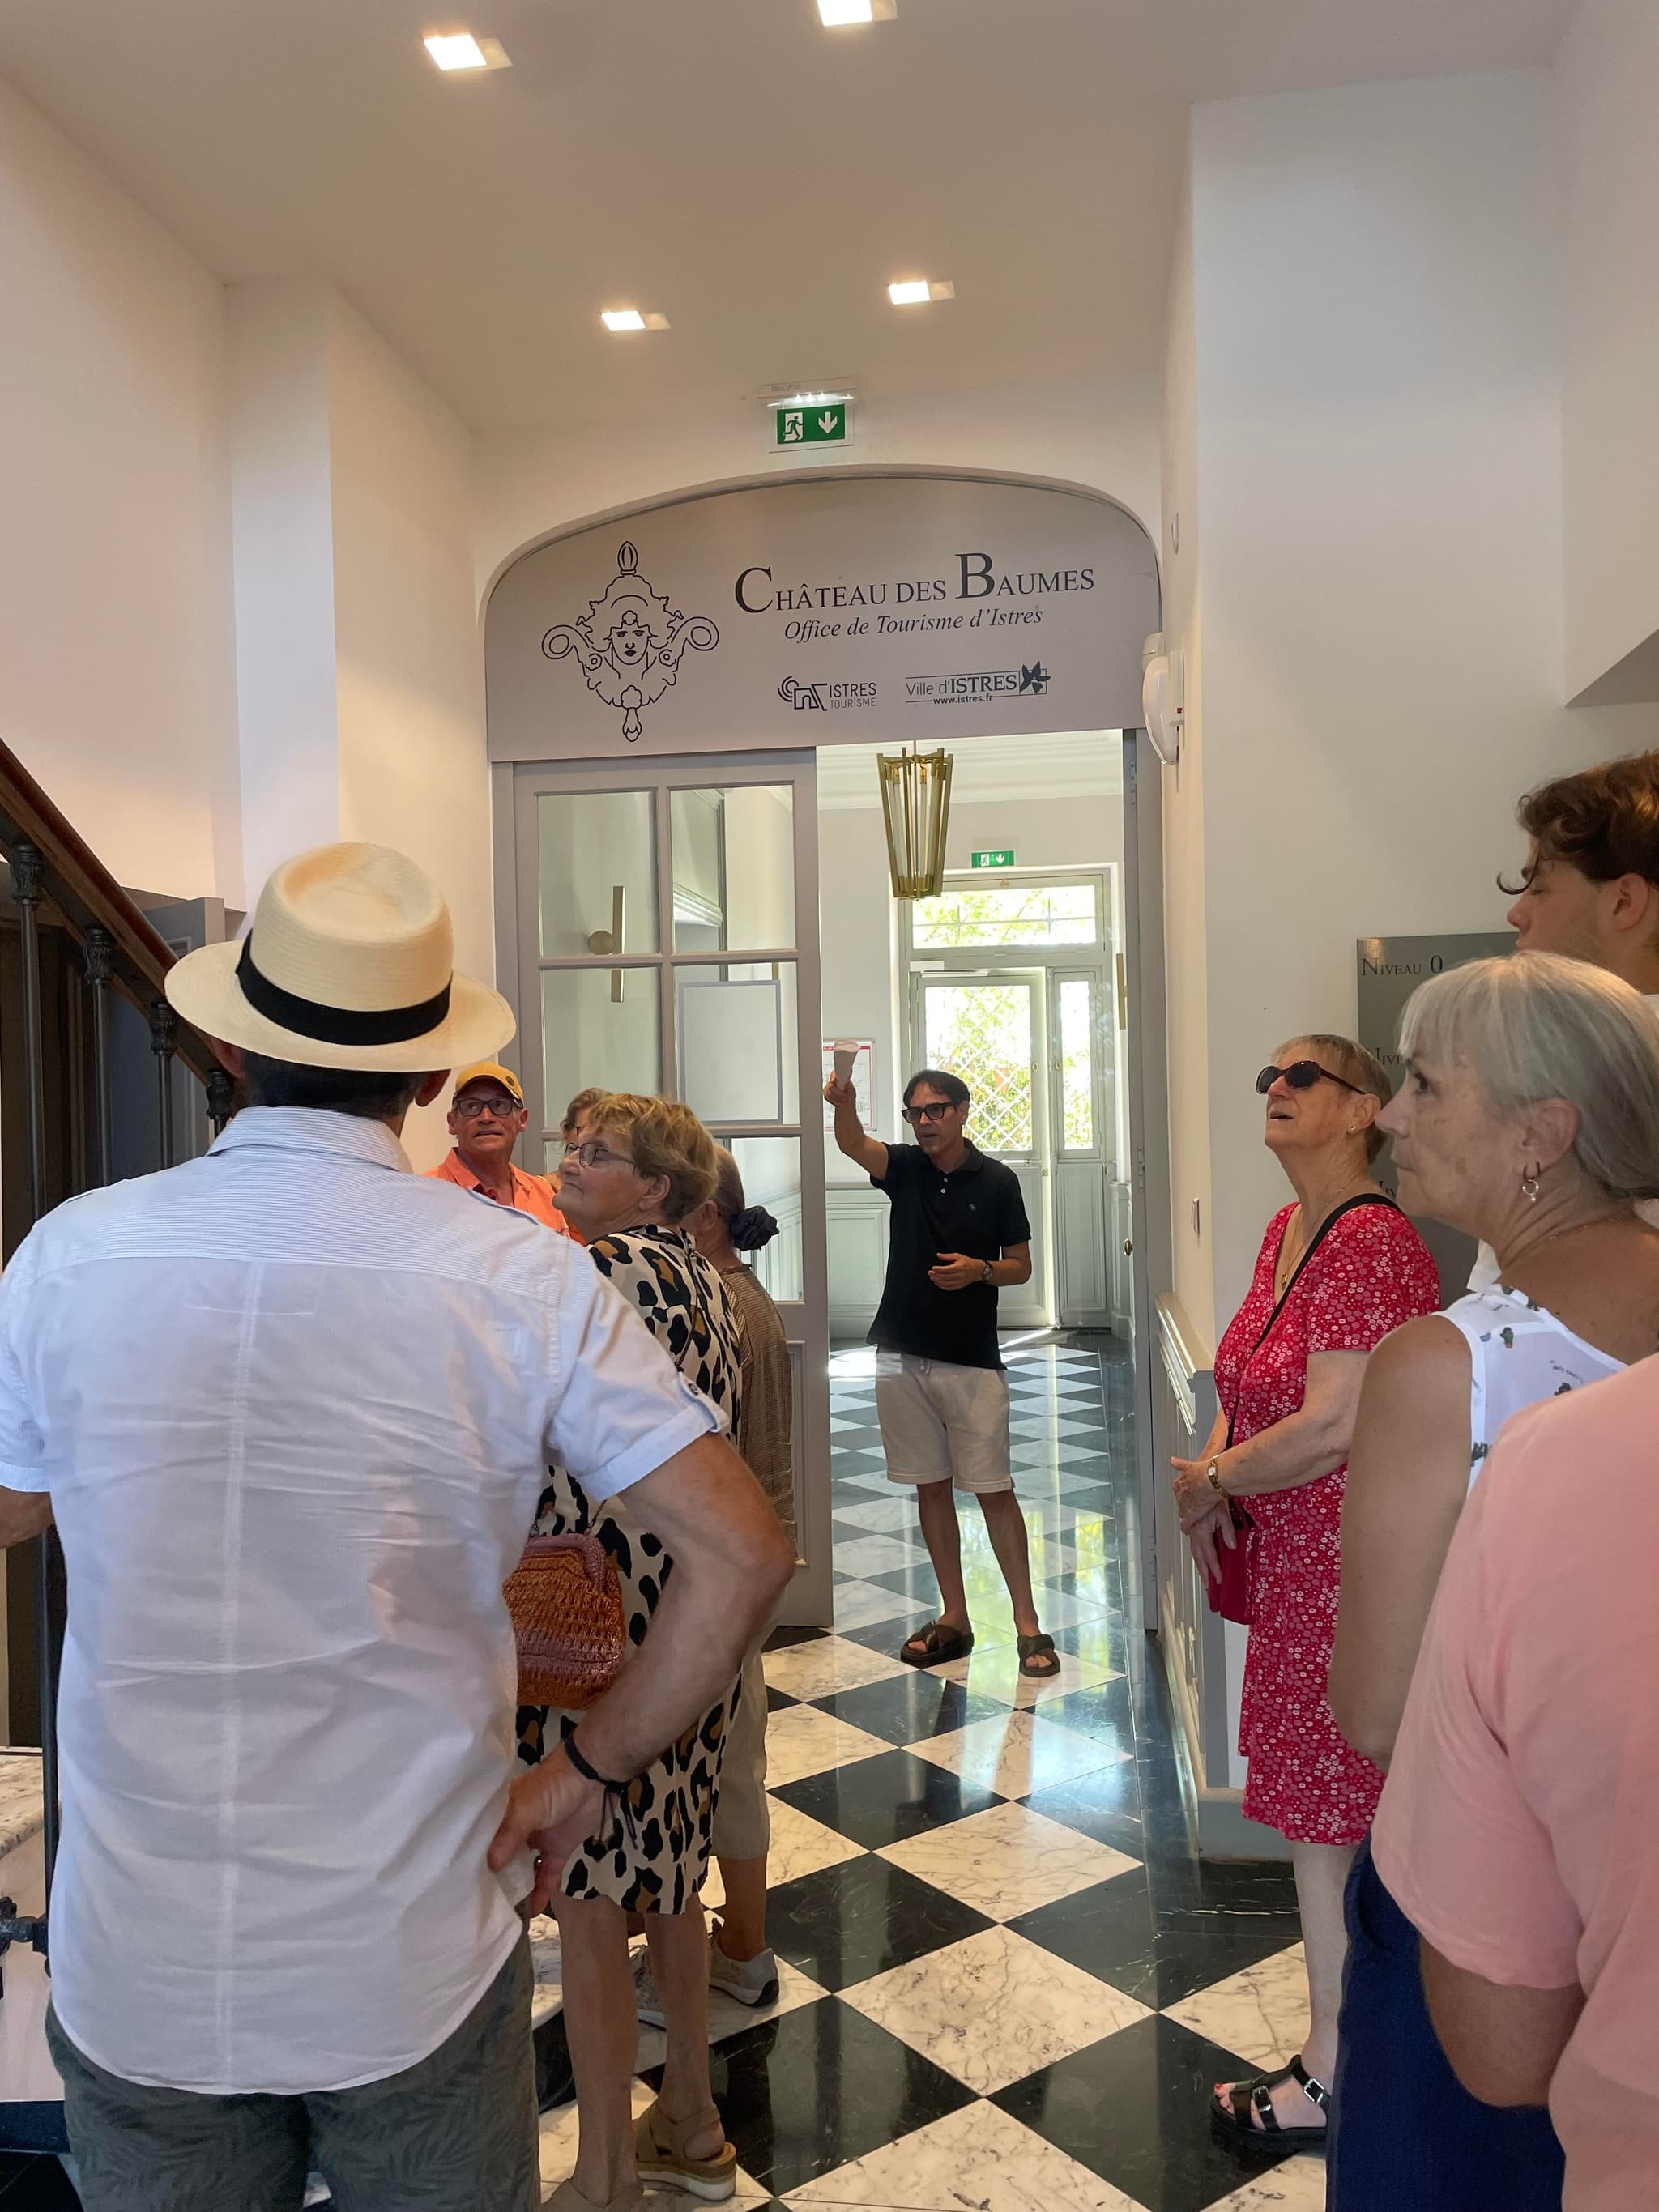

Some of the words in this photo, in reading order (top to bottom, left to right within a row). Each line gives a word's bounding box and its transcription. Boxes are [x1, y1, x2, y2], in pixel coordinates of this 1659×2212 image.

[735, 566, 887, 613] CHÂTEAU
[896, 580, 947, 603] DES
[955, 552, 1094, 599] BAUMES
[785, 619, 841, 644] Office
[847, 617, 869, 636] de
[877, 614, 963, 633] Tourisme
[970, 607, 1043, 628] d’Istres
[830, 682, 876, 698] ISTRES
[906, 682, 934, 696] Ville
[938, 674, 1017, 694] d'ISTRES
[830, 697, 876, 710] TOURISME
[933, 693, 992, 705] www.istres.fr
[1361, 958, 1422, 976] NIVEAU
[1430, 954, 1444, 974] 0
